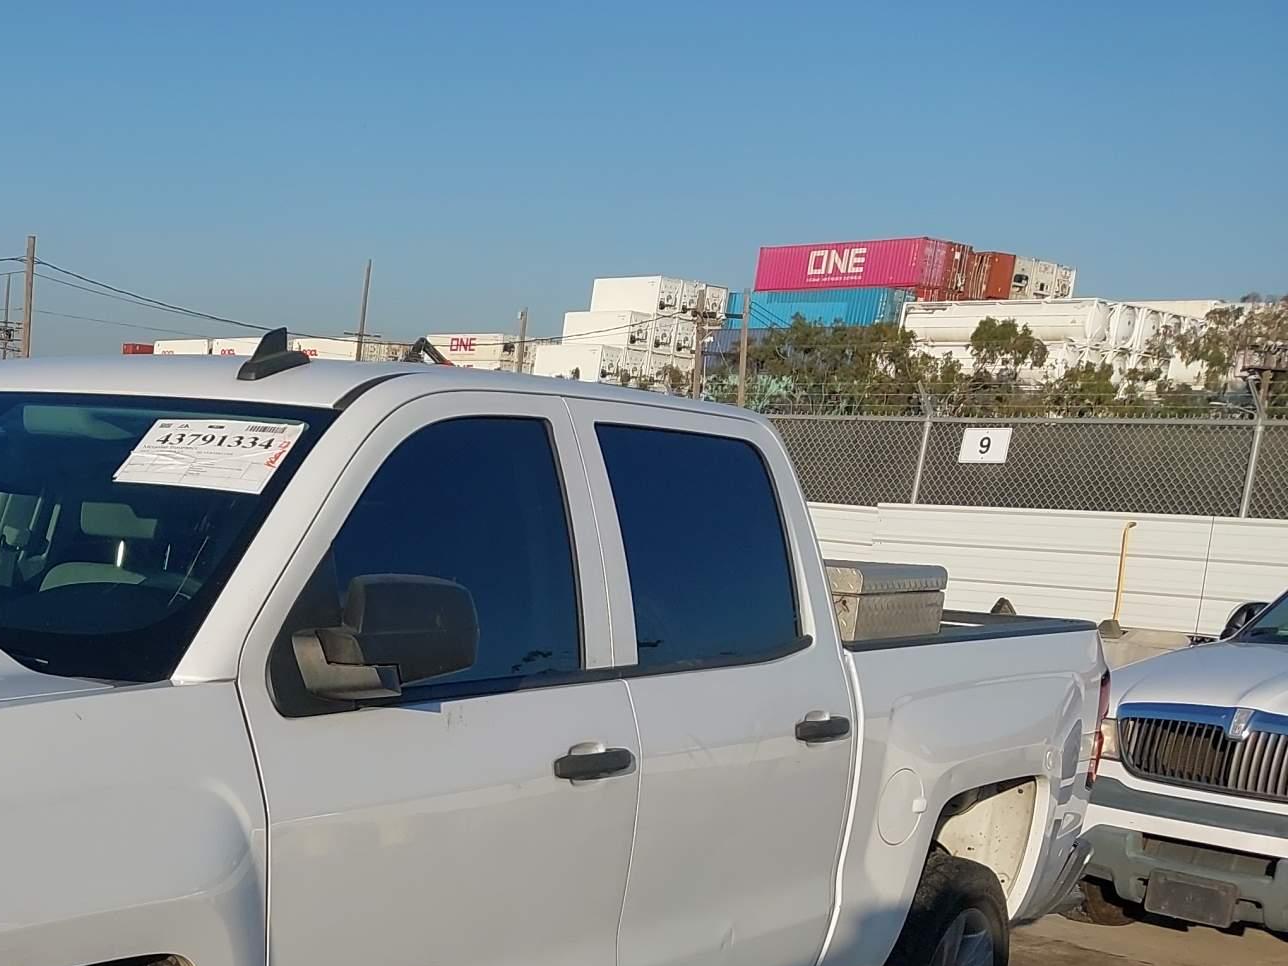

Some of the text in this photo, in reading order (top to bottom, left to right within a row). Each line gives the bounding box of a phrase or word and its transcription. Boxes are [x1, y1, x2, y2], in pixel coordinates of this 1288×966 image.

[807, 247, 867, 275] ONE
[450, 337, 477, 351] ONE
[156, 432, 275, 449] 43791334
[978, 436, 991, 454] 9
